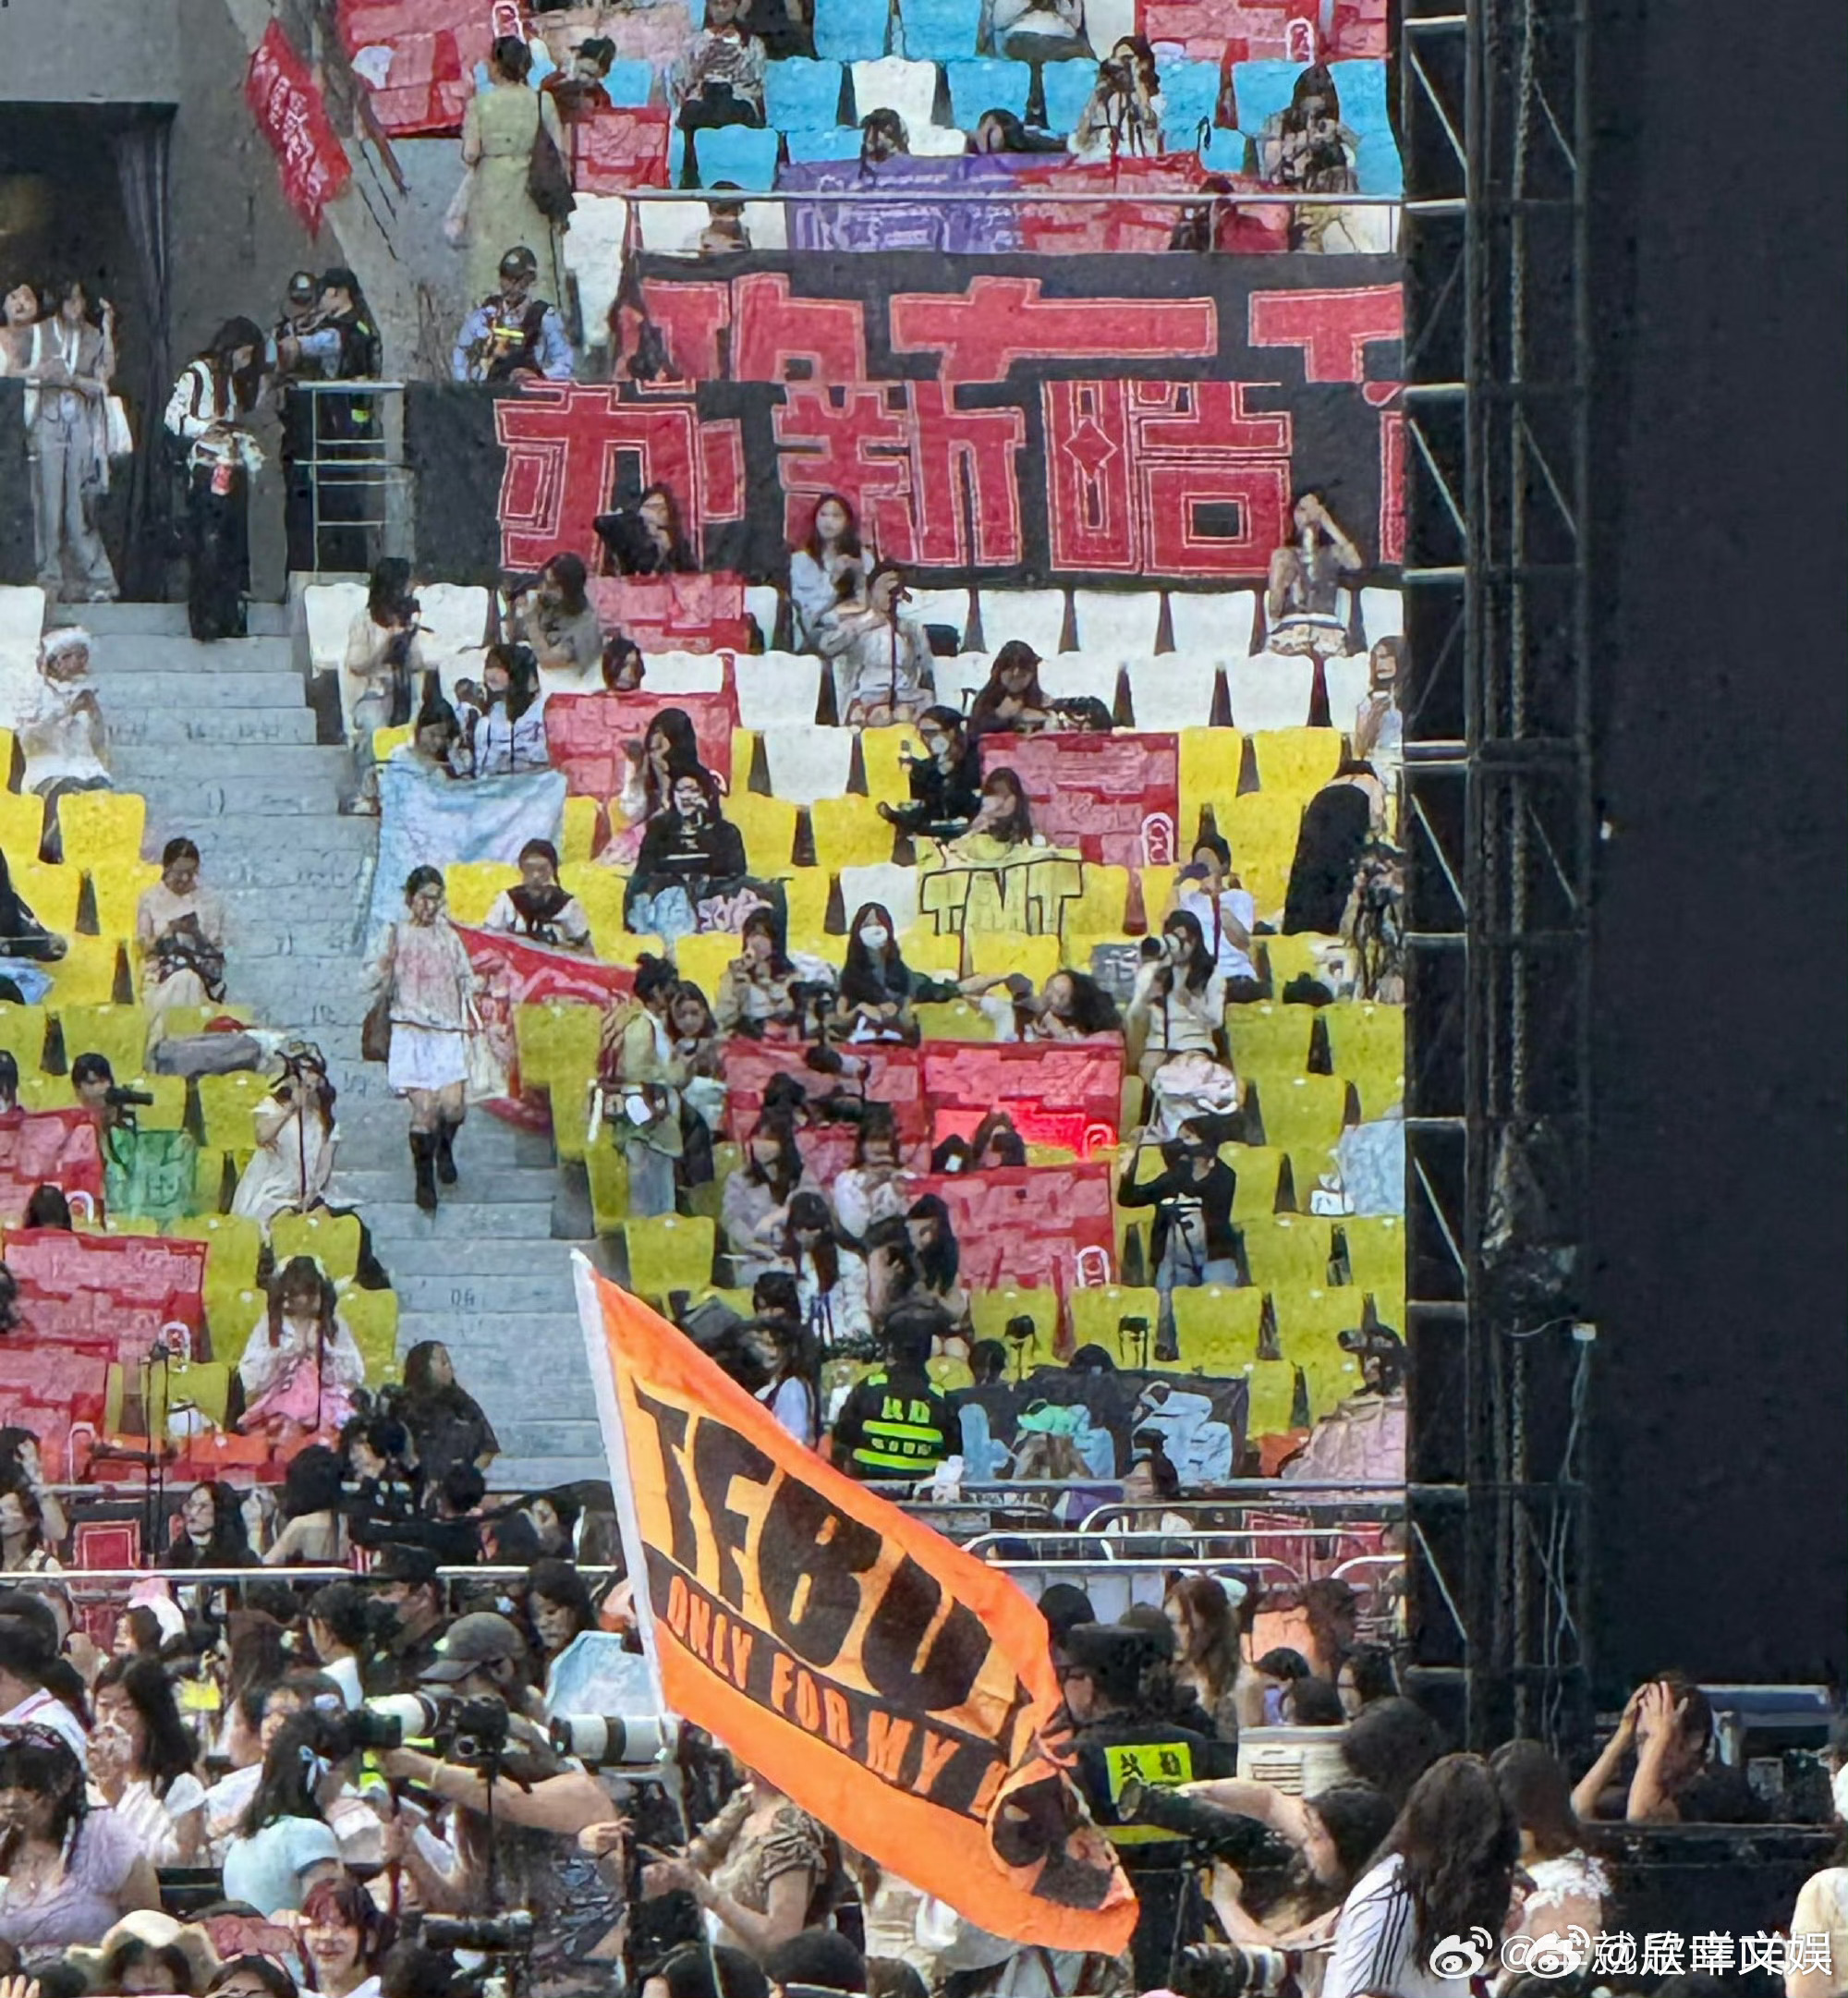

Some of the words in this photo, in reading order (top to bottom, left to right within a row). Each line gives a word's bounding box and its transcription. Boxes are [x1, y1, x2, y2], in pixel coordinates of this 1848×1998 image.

[667, 1576, 753, 1690] ONLY
[771, 1652, 853, 1750] FOR
[865, 1710, 960, 1795] MY
